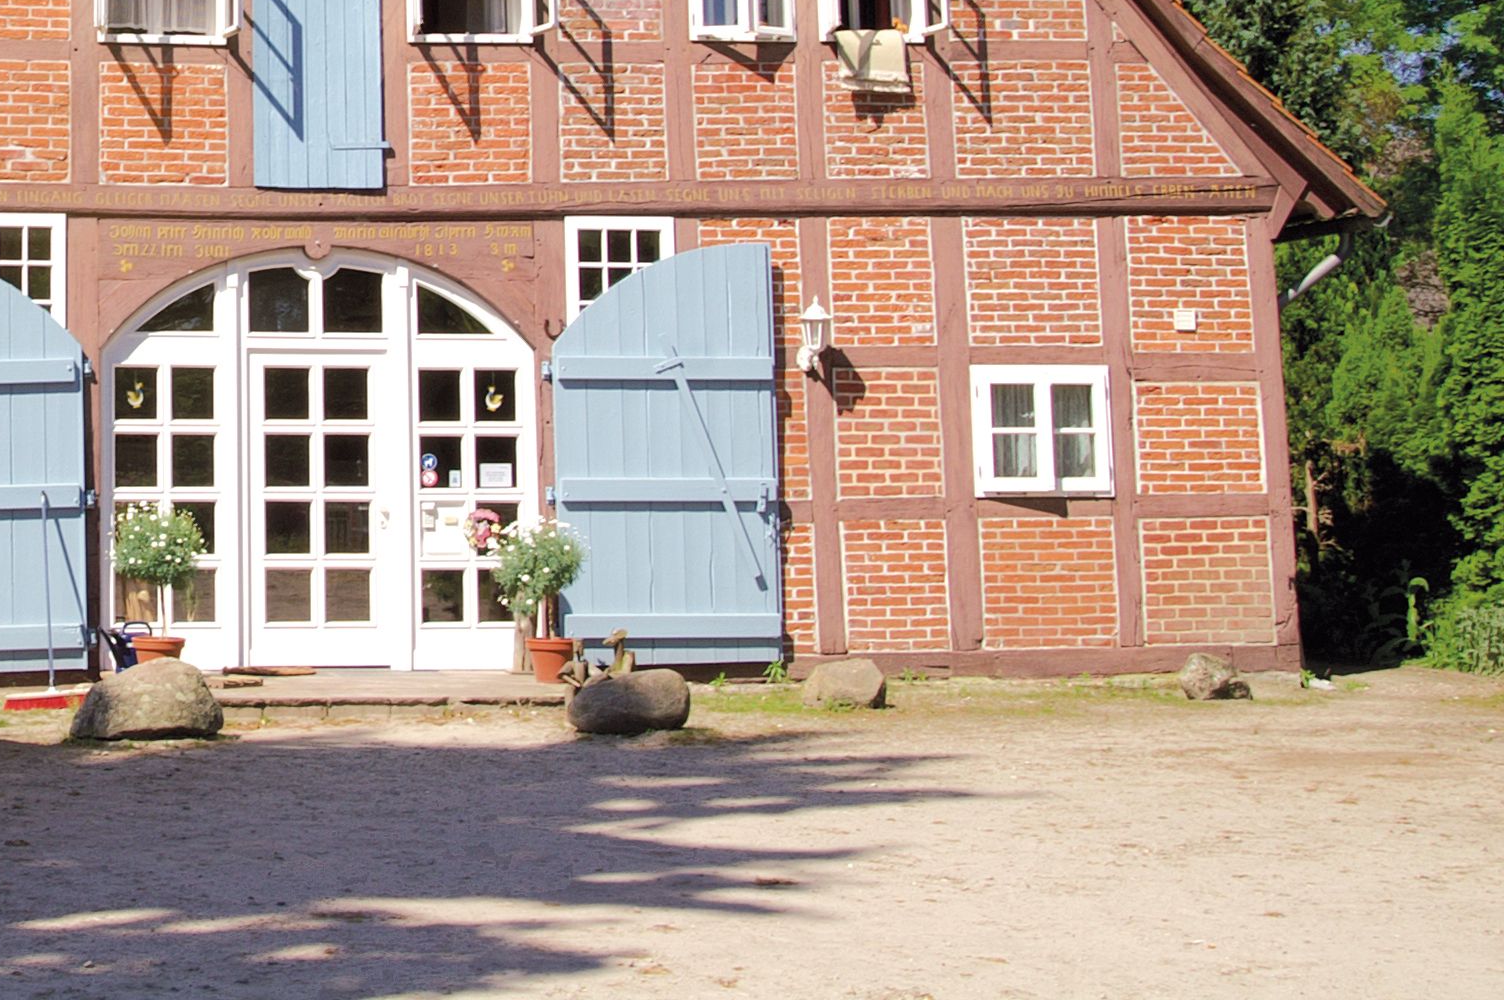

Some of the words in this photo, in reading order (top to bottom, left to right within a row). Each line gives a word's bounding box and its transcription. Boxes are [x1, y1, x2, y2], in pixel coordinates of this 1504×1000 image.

[480, 190, 524, 205] UNSER
[665, 187, 710, 202] SEGNE
[718, 187, 752, 202] UNS
[871, 184, 932, 200] STERBEN
[942, 185, 970, 200] UND
[1021, 184, 1049, 199] UNS
[415, 243, 459, 257] 1813
